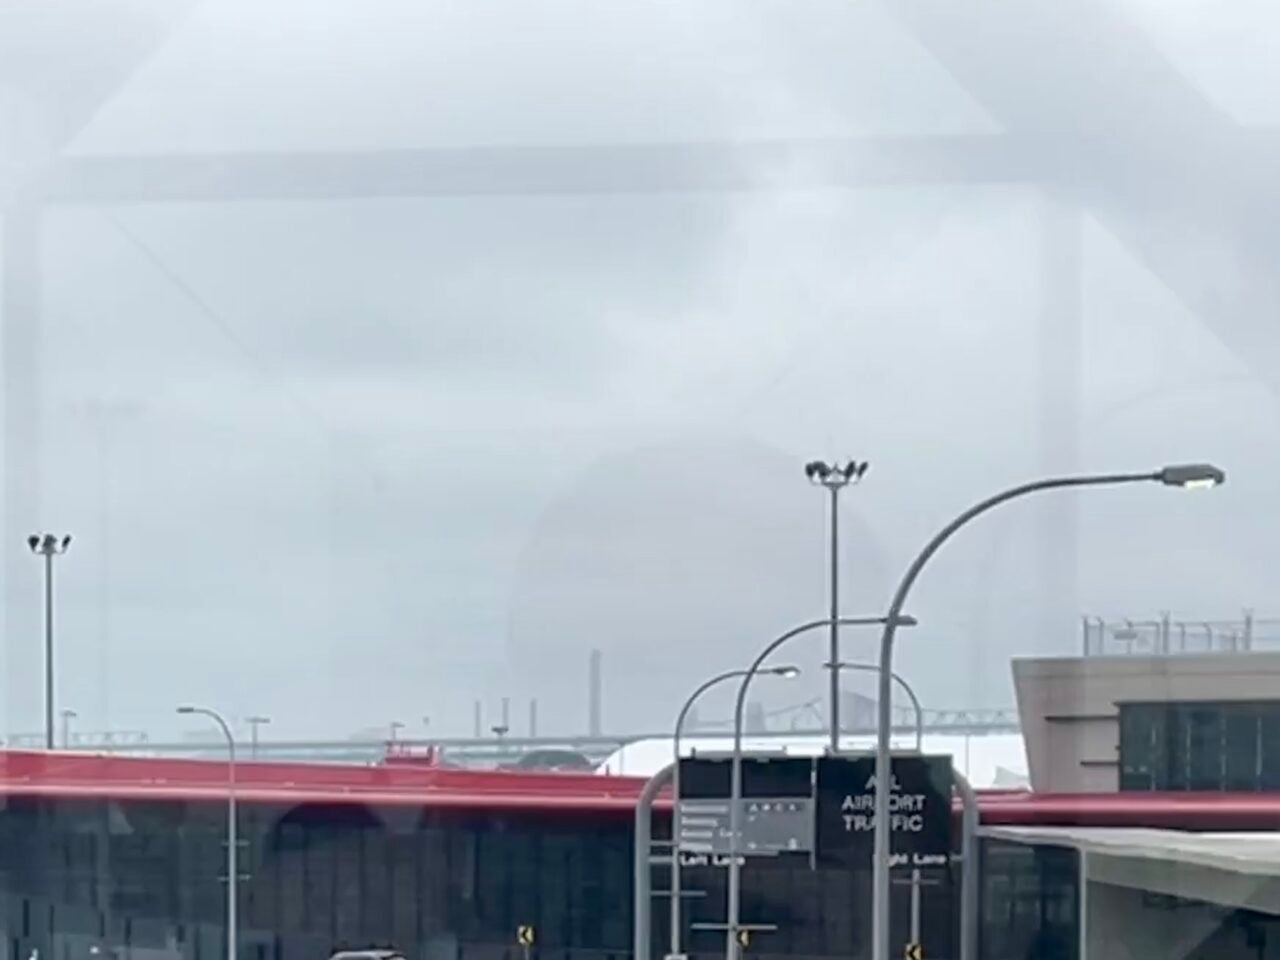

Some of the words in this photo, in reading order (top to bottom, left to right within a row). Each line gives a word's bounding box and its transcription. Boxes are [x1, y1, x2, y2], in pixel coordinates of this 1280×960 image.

[865, 774, 902, 791] AL
[842, 794, 926, 812] AIRORT
[842, 814, 923, 832] TRAFIC
[713, 852, 746, 867] Lae
